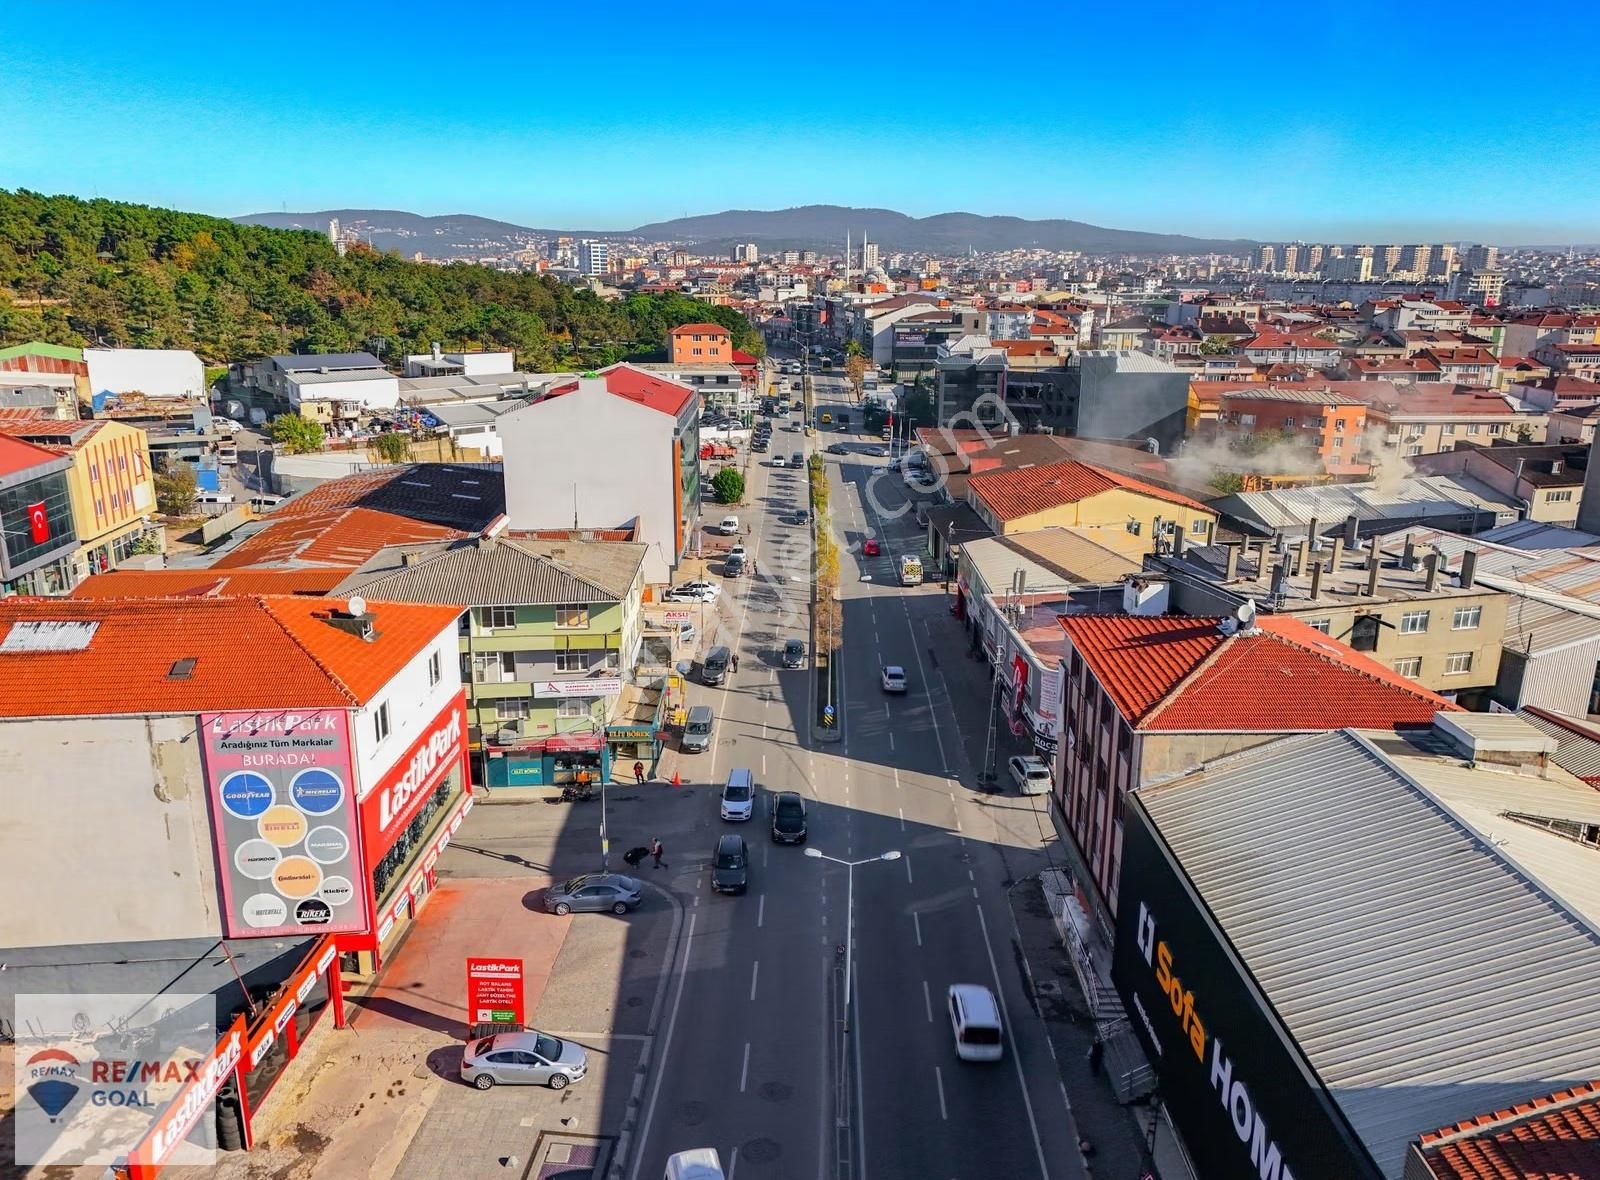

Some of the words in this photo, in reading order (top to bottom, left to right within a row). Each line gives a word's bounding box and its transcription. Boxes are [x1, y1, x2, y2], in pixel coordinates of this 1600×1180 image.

[213, 714, 337, 733] LastikPark
[221, 741, 268, 750] Aradığınız
[270, 739, 289, 748] Tüm
[292, 738, 333, 747] Markalar
[243, 753, 316, 766] BURADA!
[379, 709, 461, 832] LastikPark
[264, 822, 299, 832] PIRELLI
[255, 908, 282, 916] WATERFALL
[471, 963, 519, 972] LastikPark
[1156, 941, 1206, 1064] Sofa
[152, 1031, 241, 1163] LastikPark
